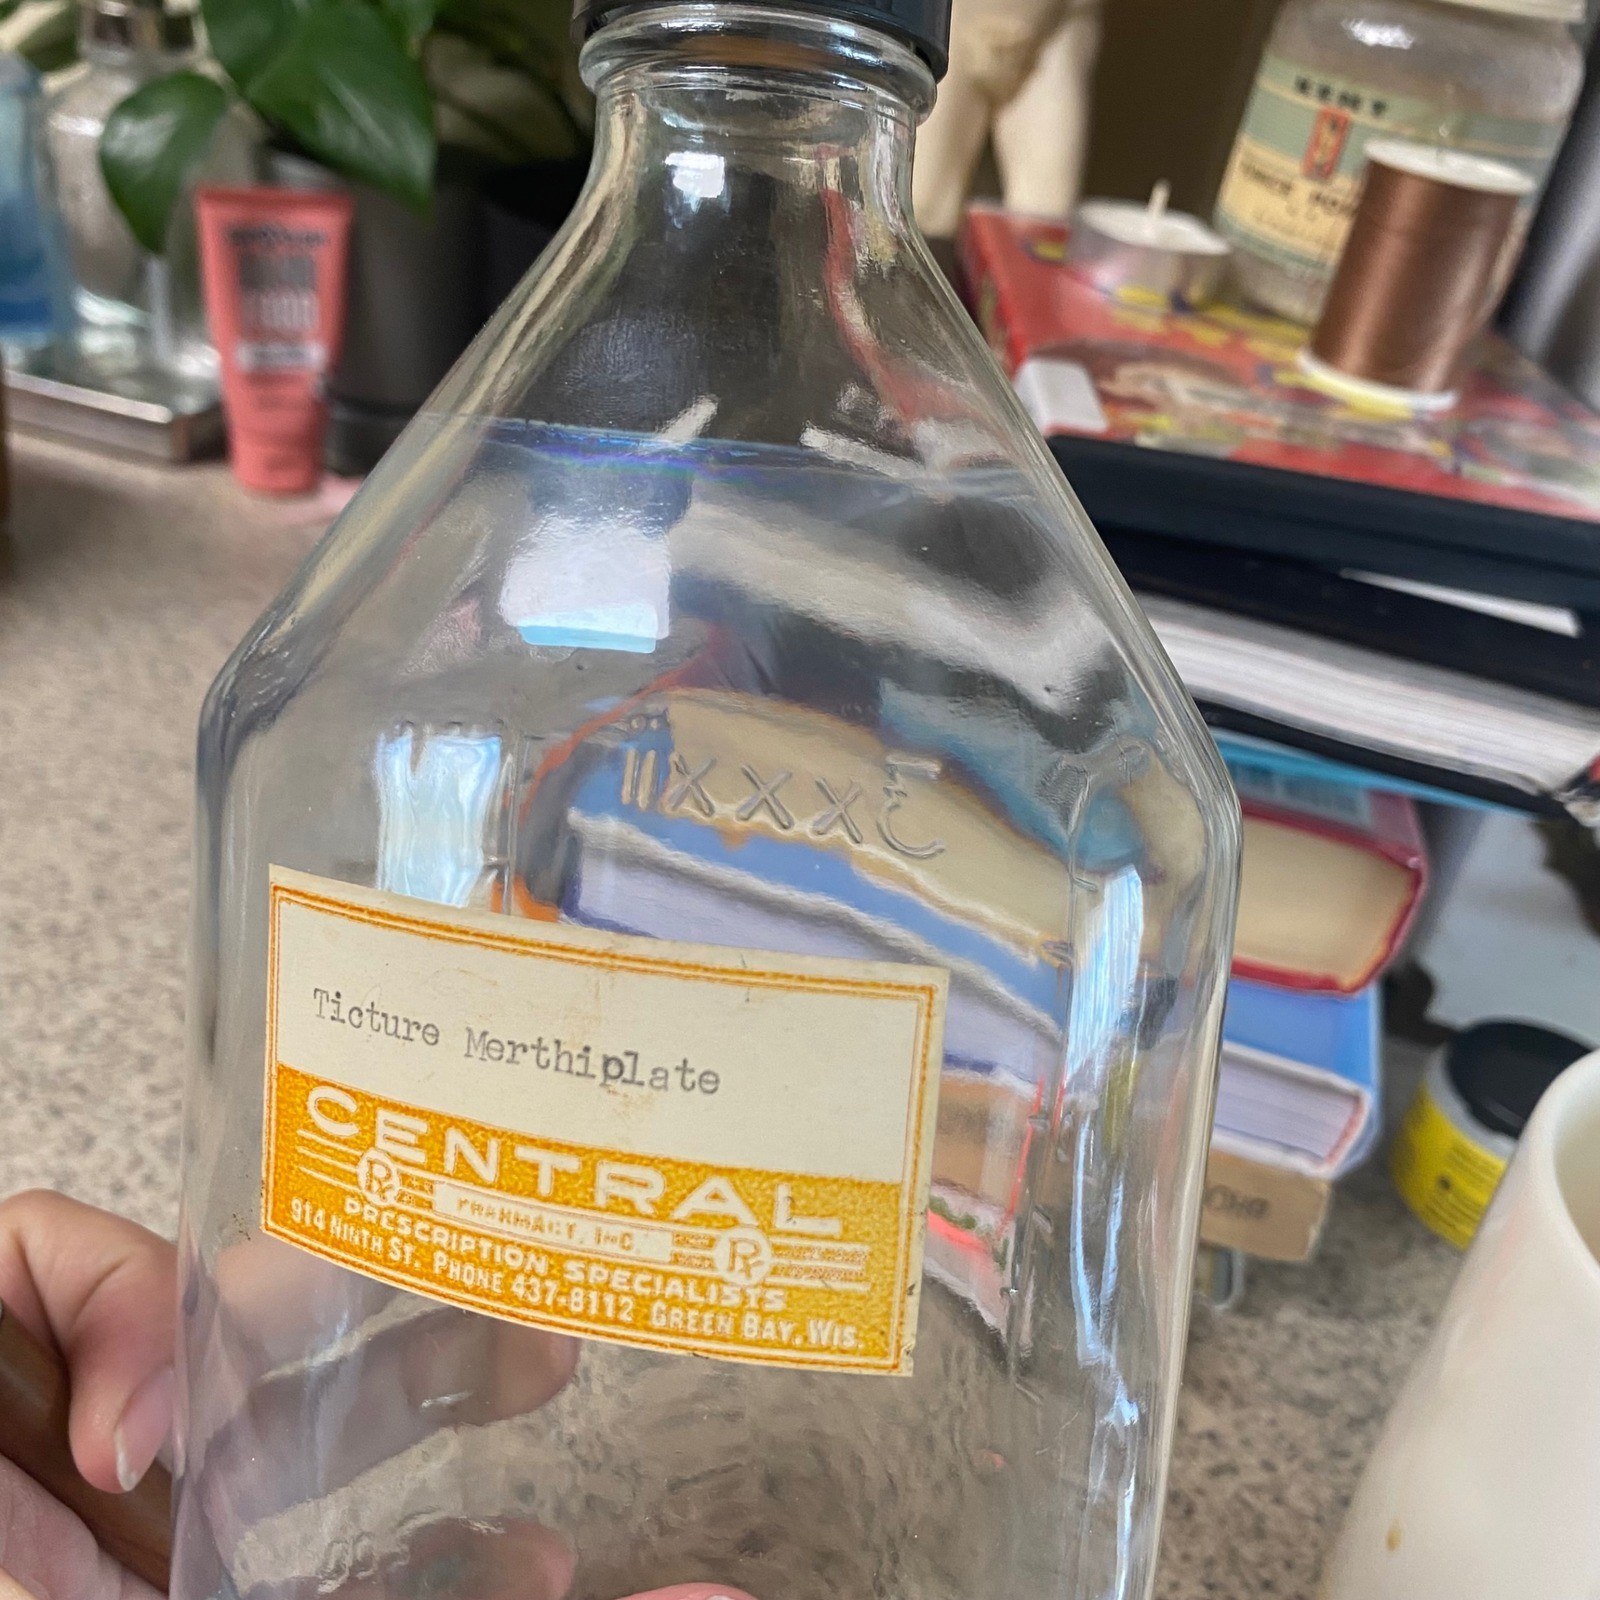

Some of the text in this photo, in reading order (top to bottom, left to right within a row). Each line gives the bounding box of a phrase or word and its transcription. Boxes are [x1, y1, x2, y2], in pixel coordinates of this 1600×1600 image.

[313, 987, 720, 1094] Ticture Merthiplate
[307, 1086, 843, 1236] CENTRAL
[291, 1198, 325, 1231] 914
[434, 1251, 503, 1294] PHONE
[511, 1273, 634, 1322] 437-8112
[651, 1301, 734, 1336] GREEN
[344, 1197, 786, 1311] PRESCRIPTION SPECIALISTS
